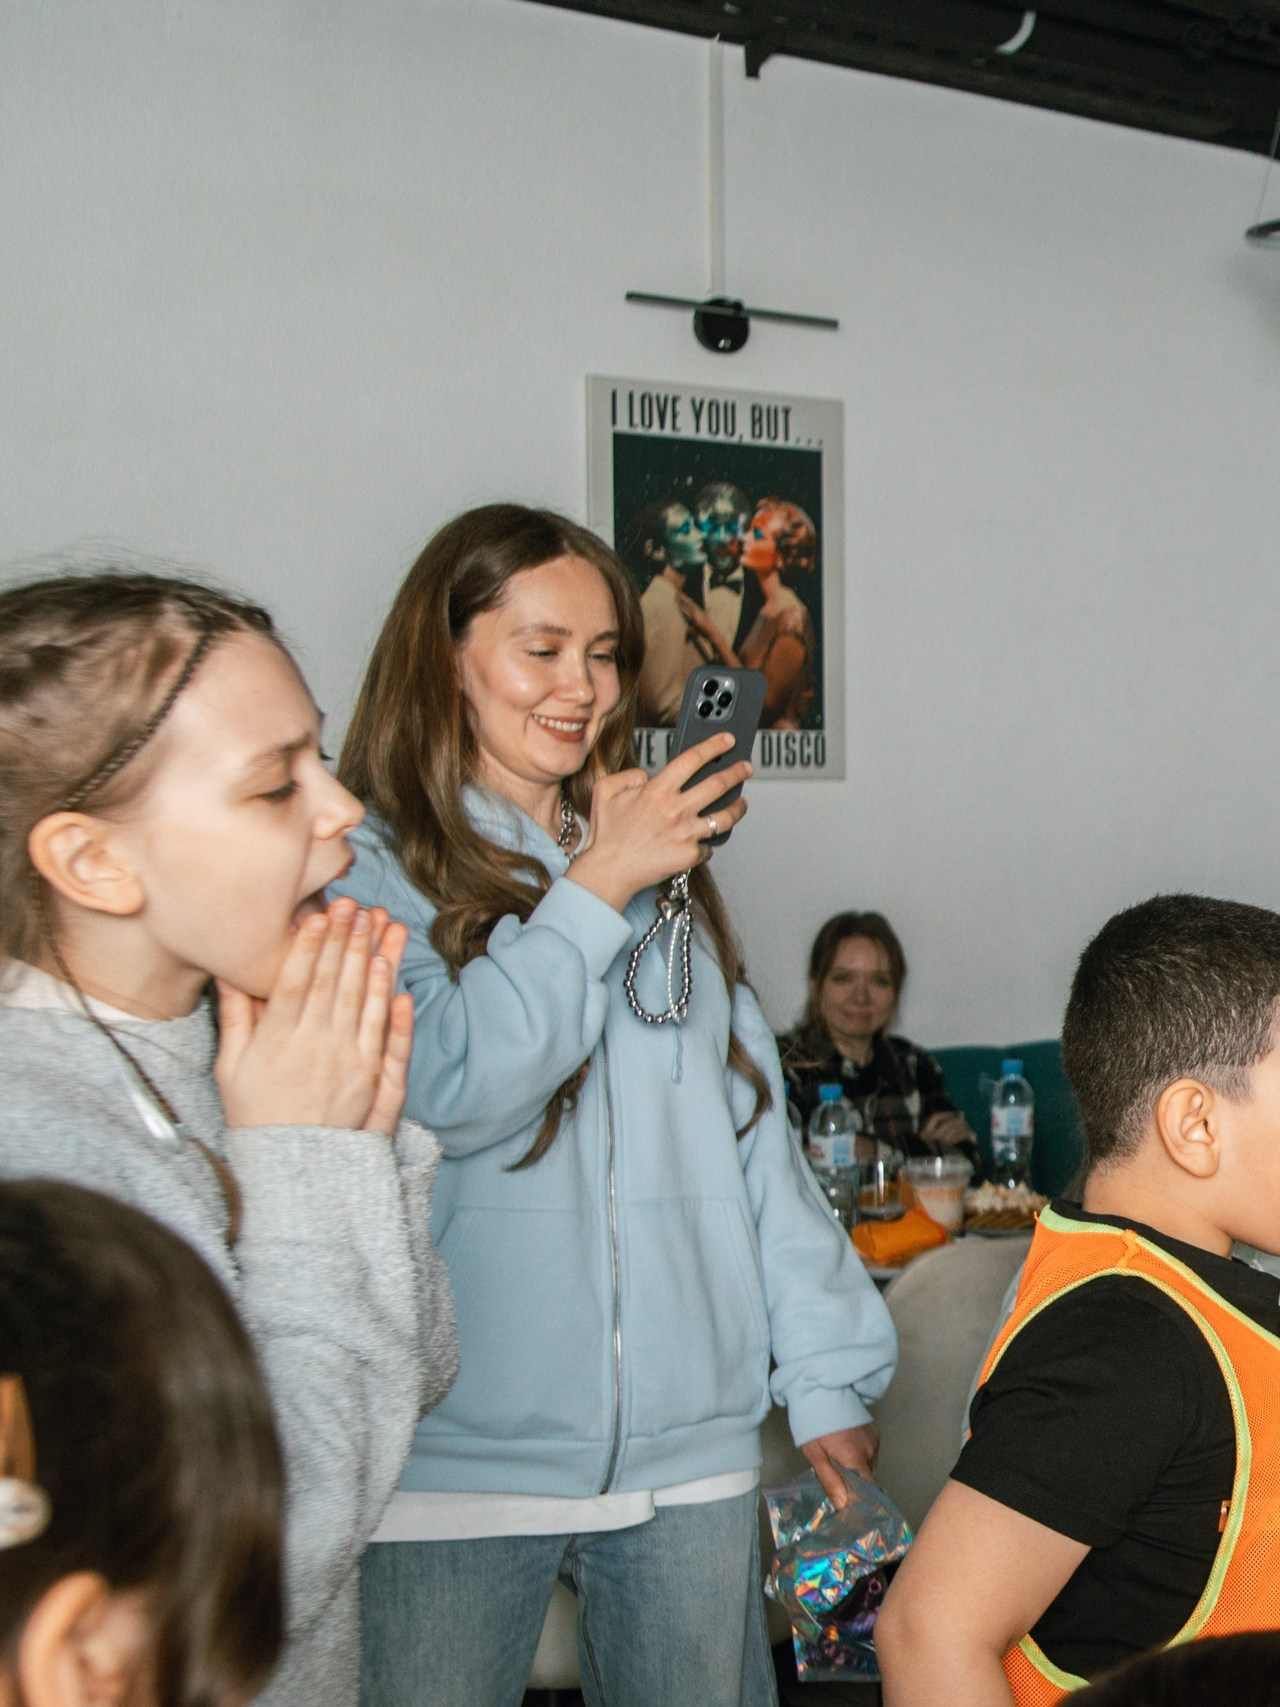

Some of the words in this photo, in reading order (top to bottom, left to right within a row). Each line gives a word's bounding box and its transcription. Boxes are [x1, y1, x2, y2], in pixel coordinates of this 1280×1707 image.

[611, 388, 618, 427] I
[628, 390, 682, 432] LOVE
[690, 396, 744, 444] YOU,
[760, 730, 827, 768] DISCO
